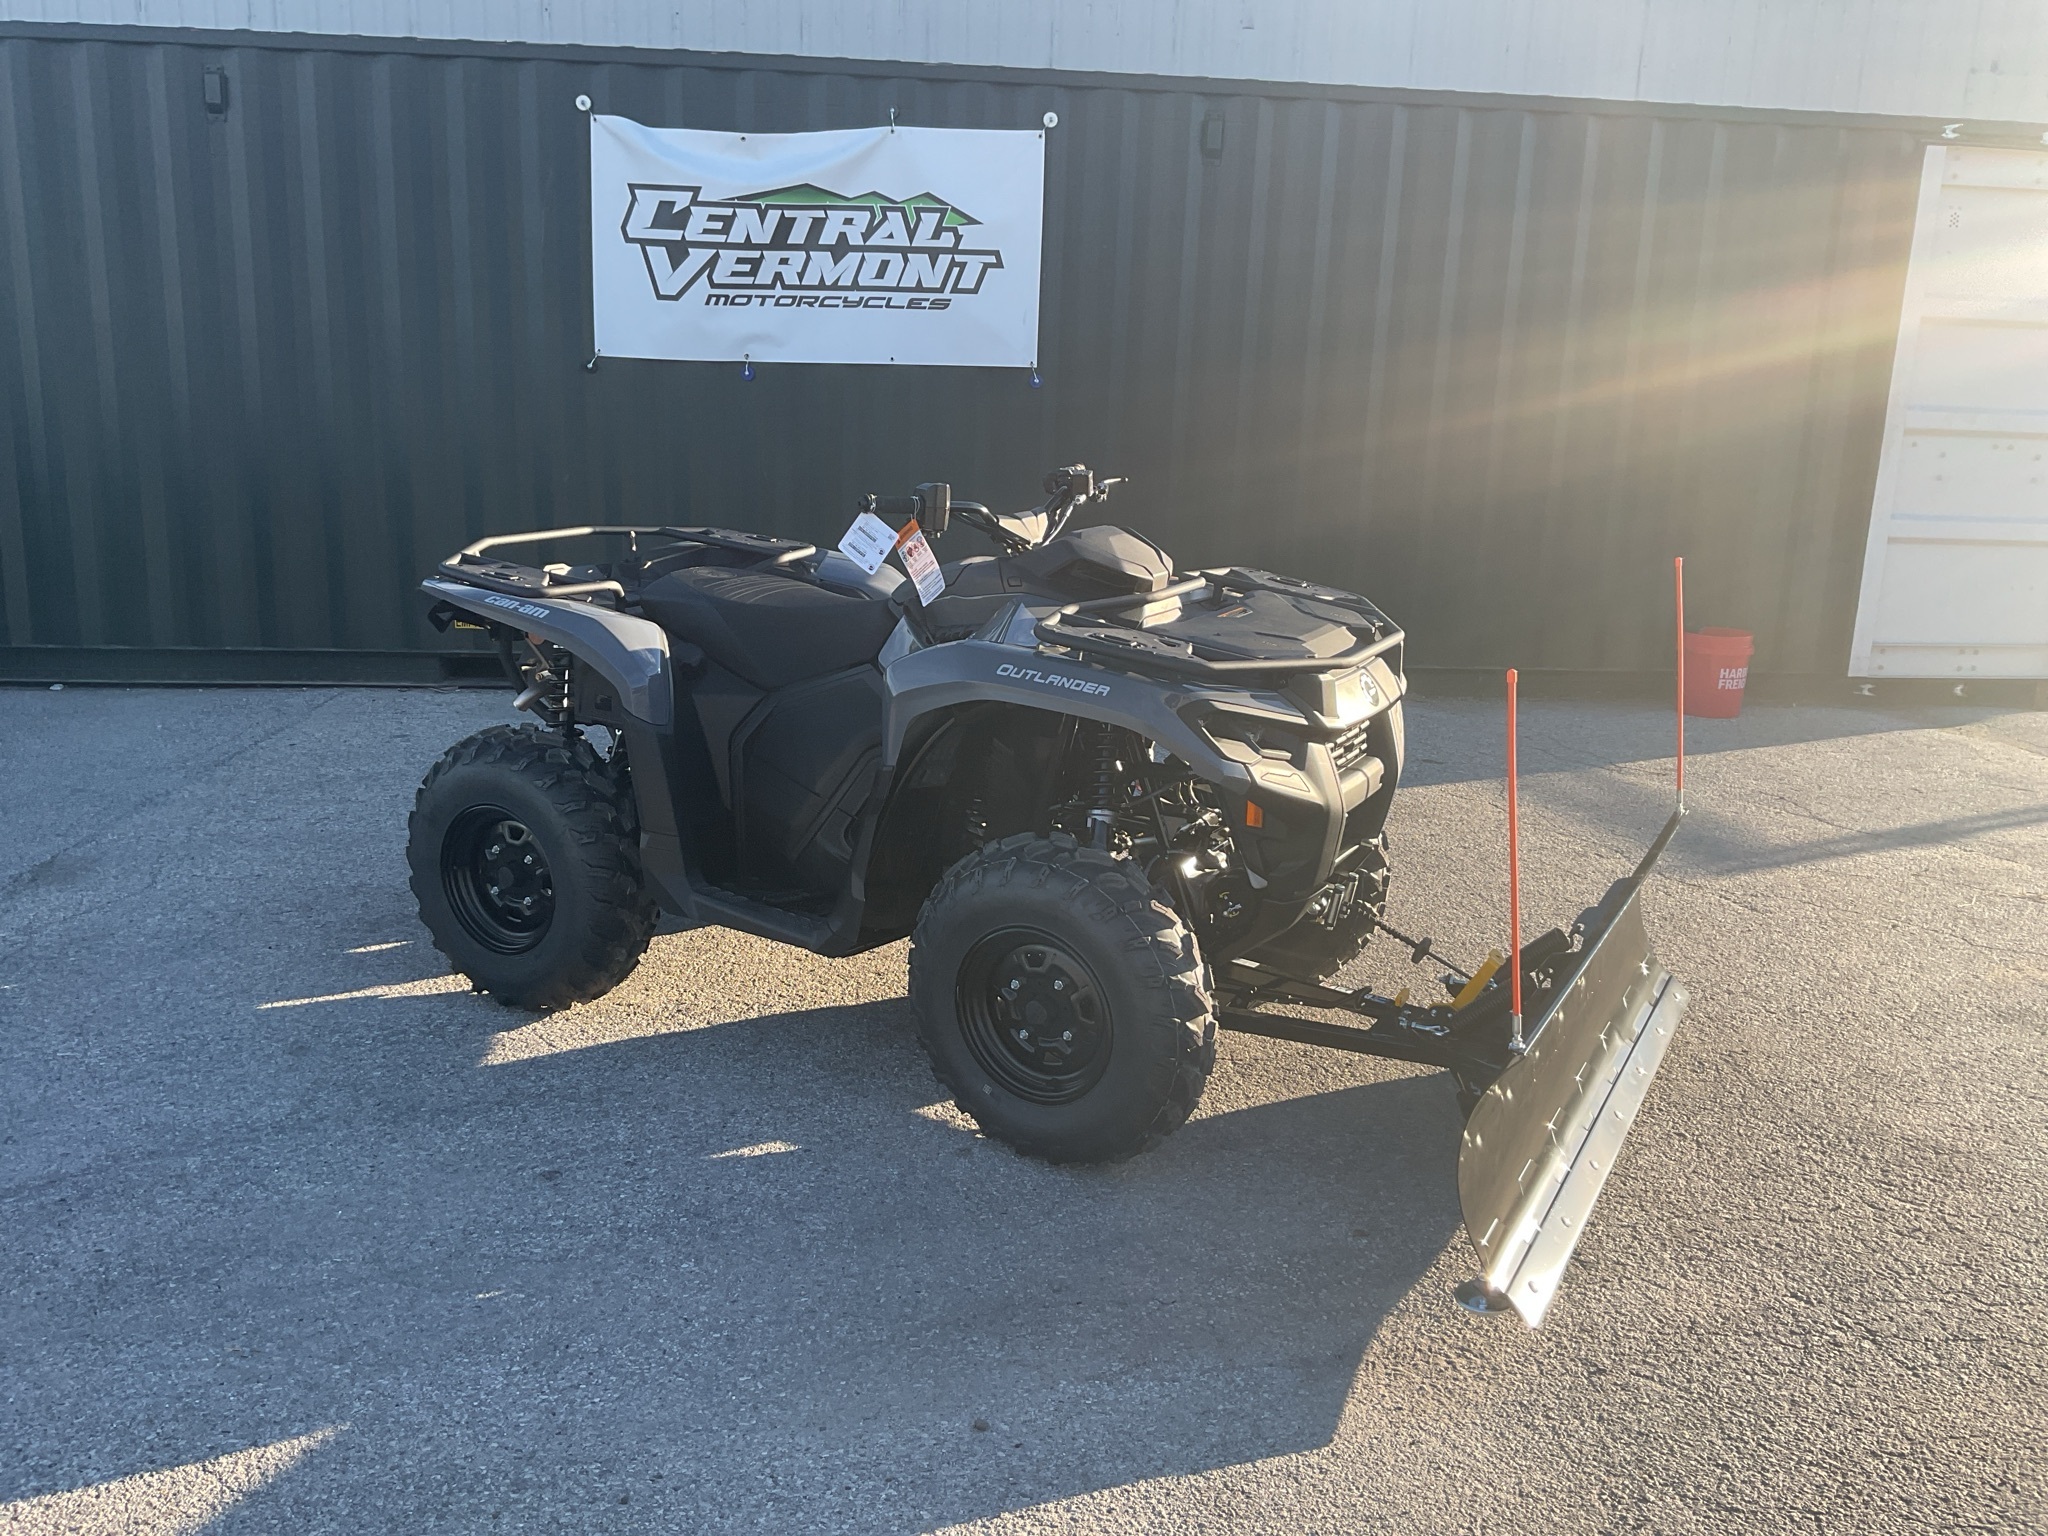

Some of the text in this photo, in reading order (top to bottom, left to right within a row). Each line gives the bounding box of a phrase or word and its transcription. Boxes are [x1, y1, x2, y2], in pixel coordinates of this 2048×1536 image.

[623, 185, 966, 248] CENTRAL
[643, 246, 1004, 300] VERMONT
[705, 293, 952, 310] MOTORCYCLES
[484, 595, 551, 619] can-am
[996, 663, 1111, 697] OUTLANDER
